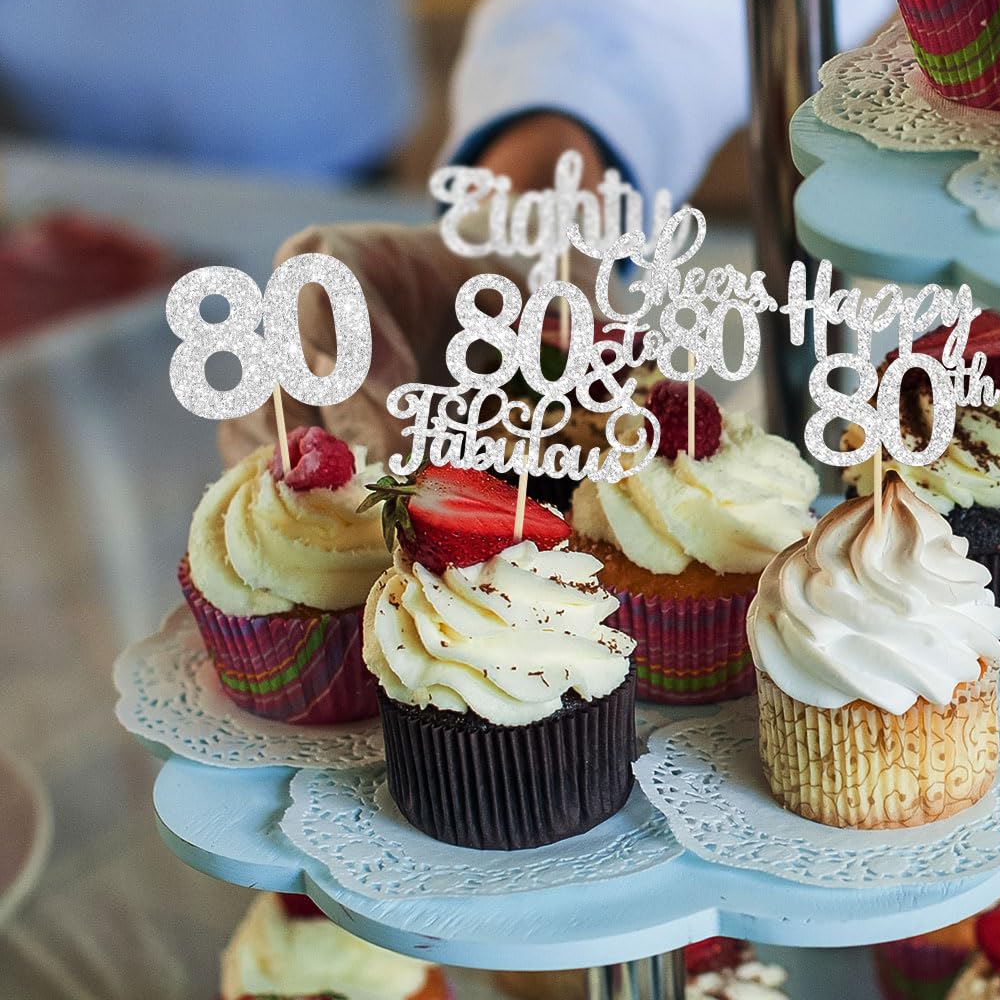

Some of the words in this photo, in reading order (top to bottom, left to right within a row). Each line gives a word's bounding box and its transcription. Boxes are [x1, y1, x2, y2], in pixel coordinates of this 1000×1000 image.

[566, 207, 778, 321] Cheers
[779, 258, 983, 369] Happy
[165, 252, 373, 420] 80
[602, 320, 663, 368] to
[657, 296, 762, 382] 80
[385, 383, 662, 484] Fabulous
